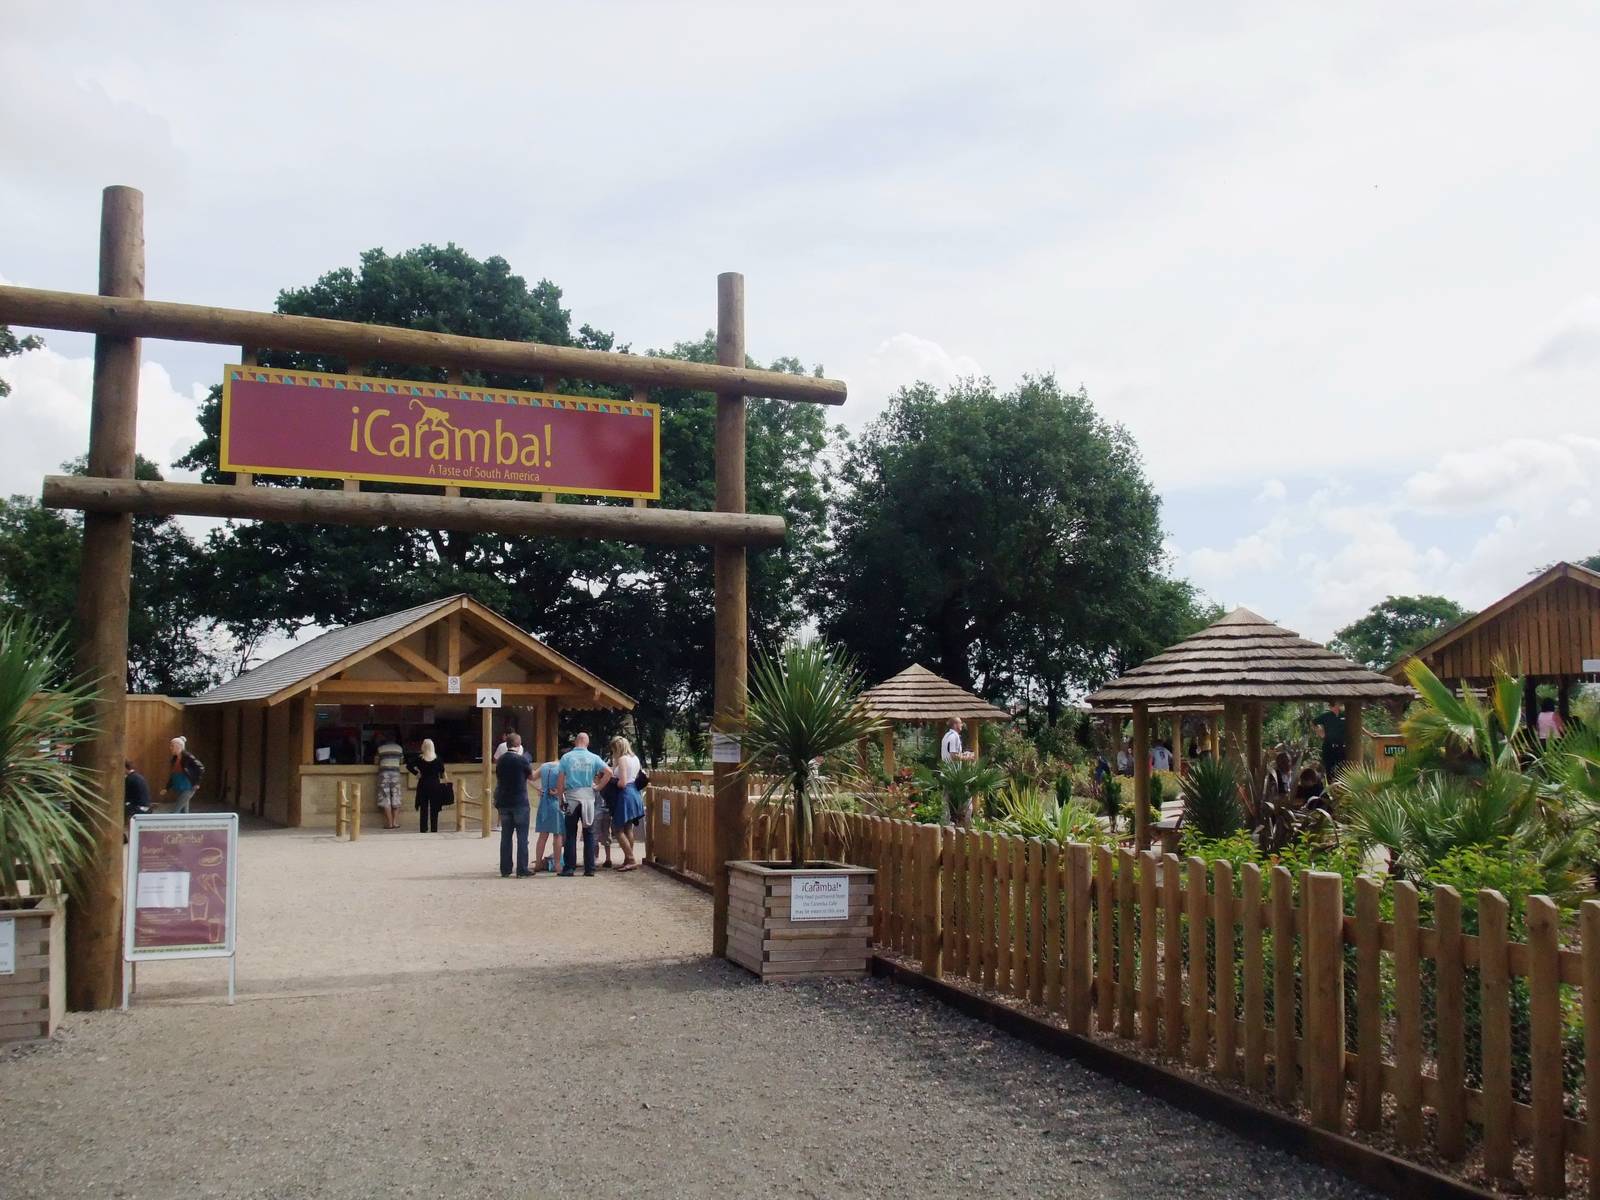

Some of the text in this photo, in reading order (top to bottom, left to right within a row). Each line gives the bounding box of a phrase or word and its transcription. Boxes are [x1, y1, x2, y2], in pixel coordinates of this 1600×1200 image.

[350, 405, 551, 468] ¡Caramba!
[428, 465, 540, 482] A Taste of South America
